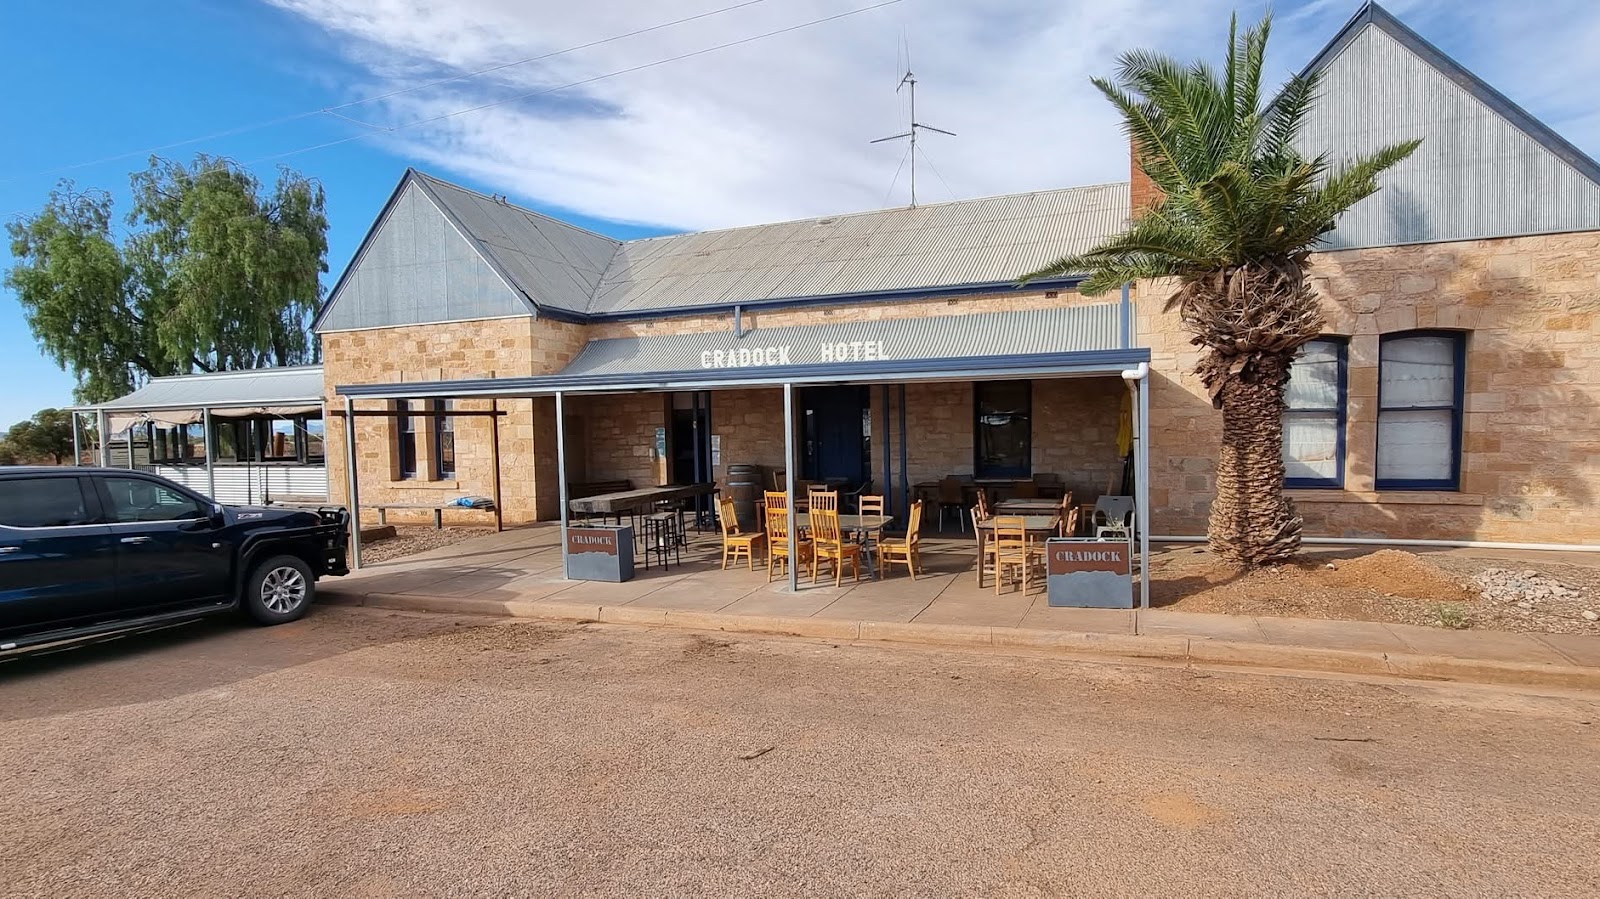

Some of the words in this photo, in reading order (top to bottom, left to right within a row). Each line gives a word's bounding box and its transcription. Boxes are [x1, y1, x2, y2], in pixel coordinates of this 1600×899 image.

[700, 345, 791, 369] CRADOCK
[821, 340, 890, 363] HOTEL
[571, 535, 612, 545] CRADOCK
[1055, 551, 1121, 562] CRADOCK
